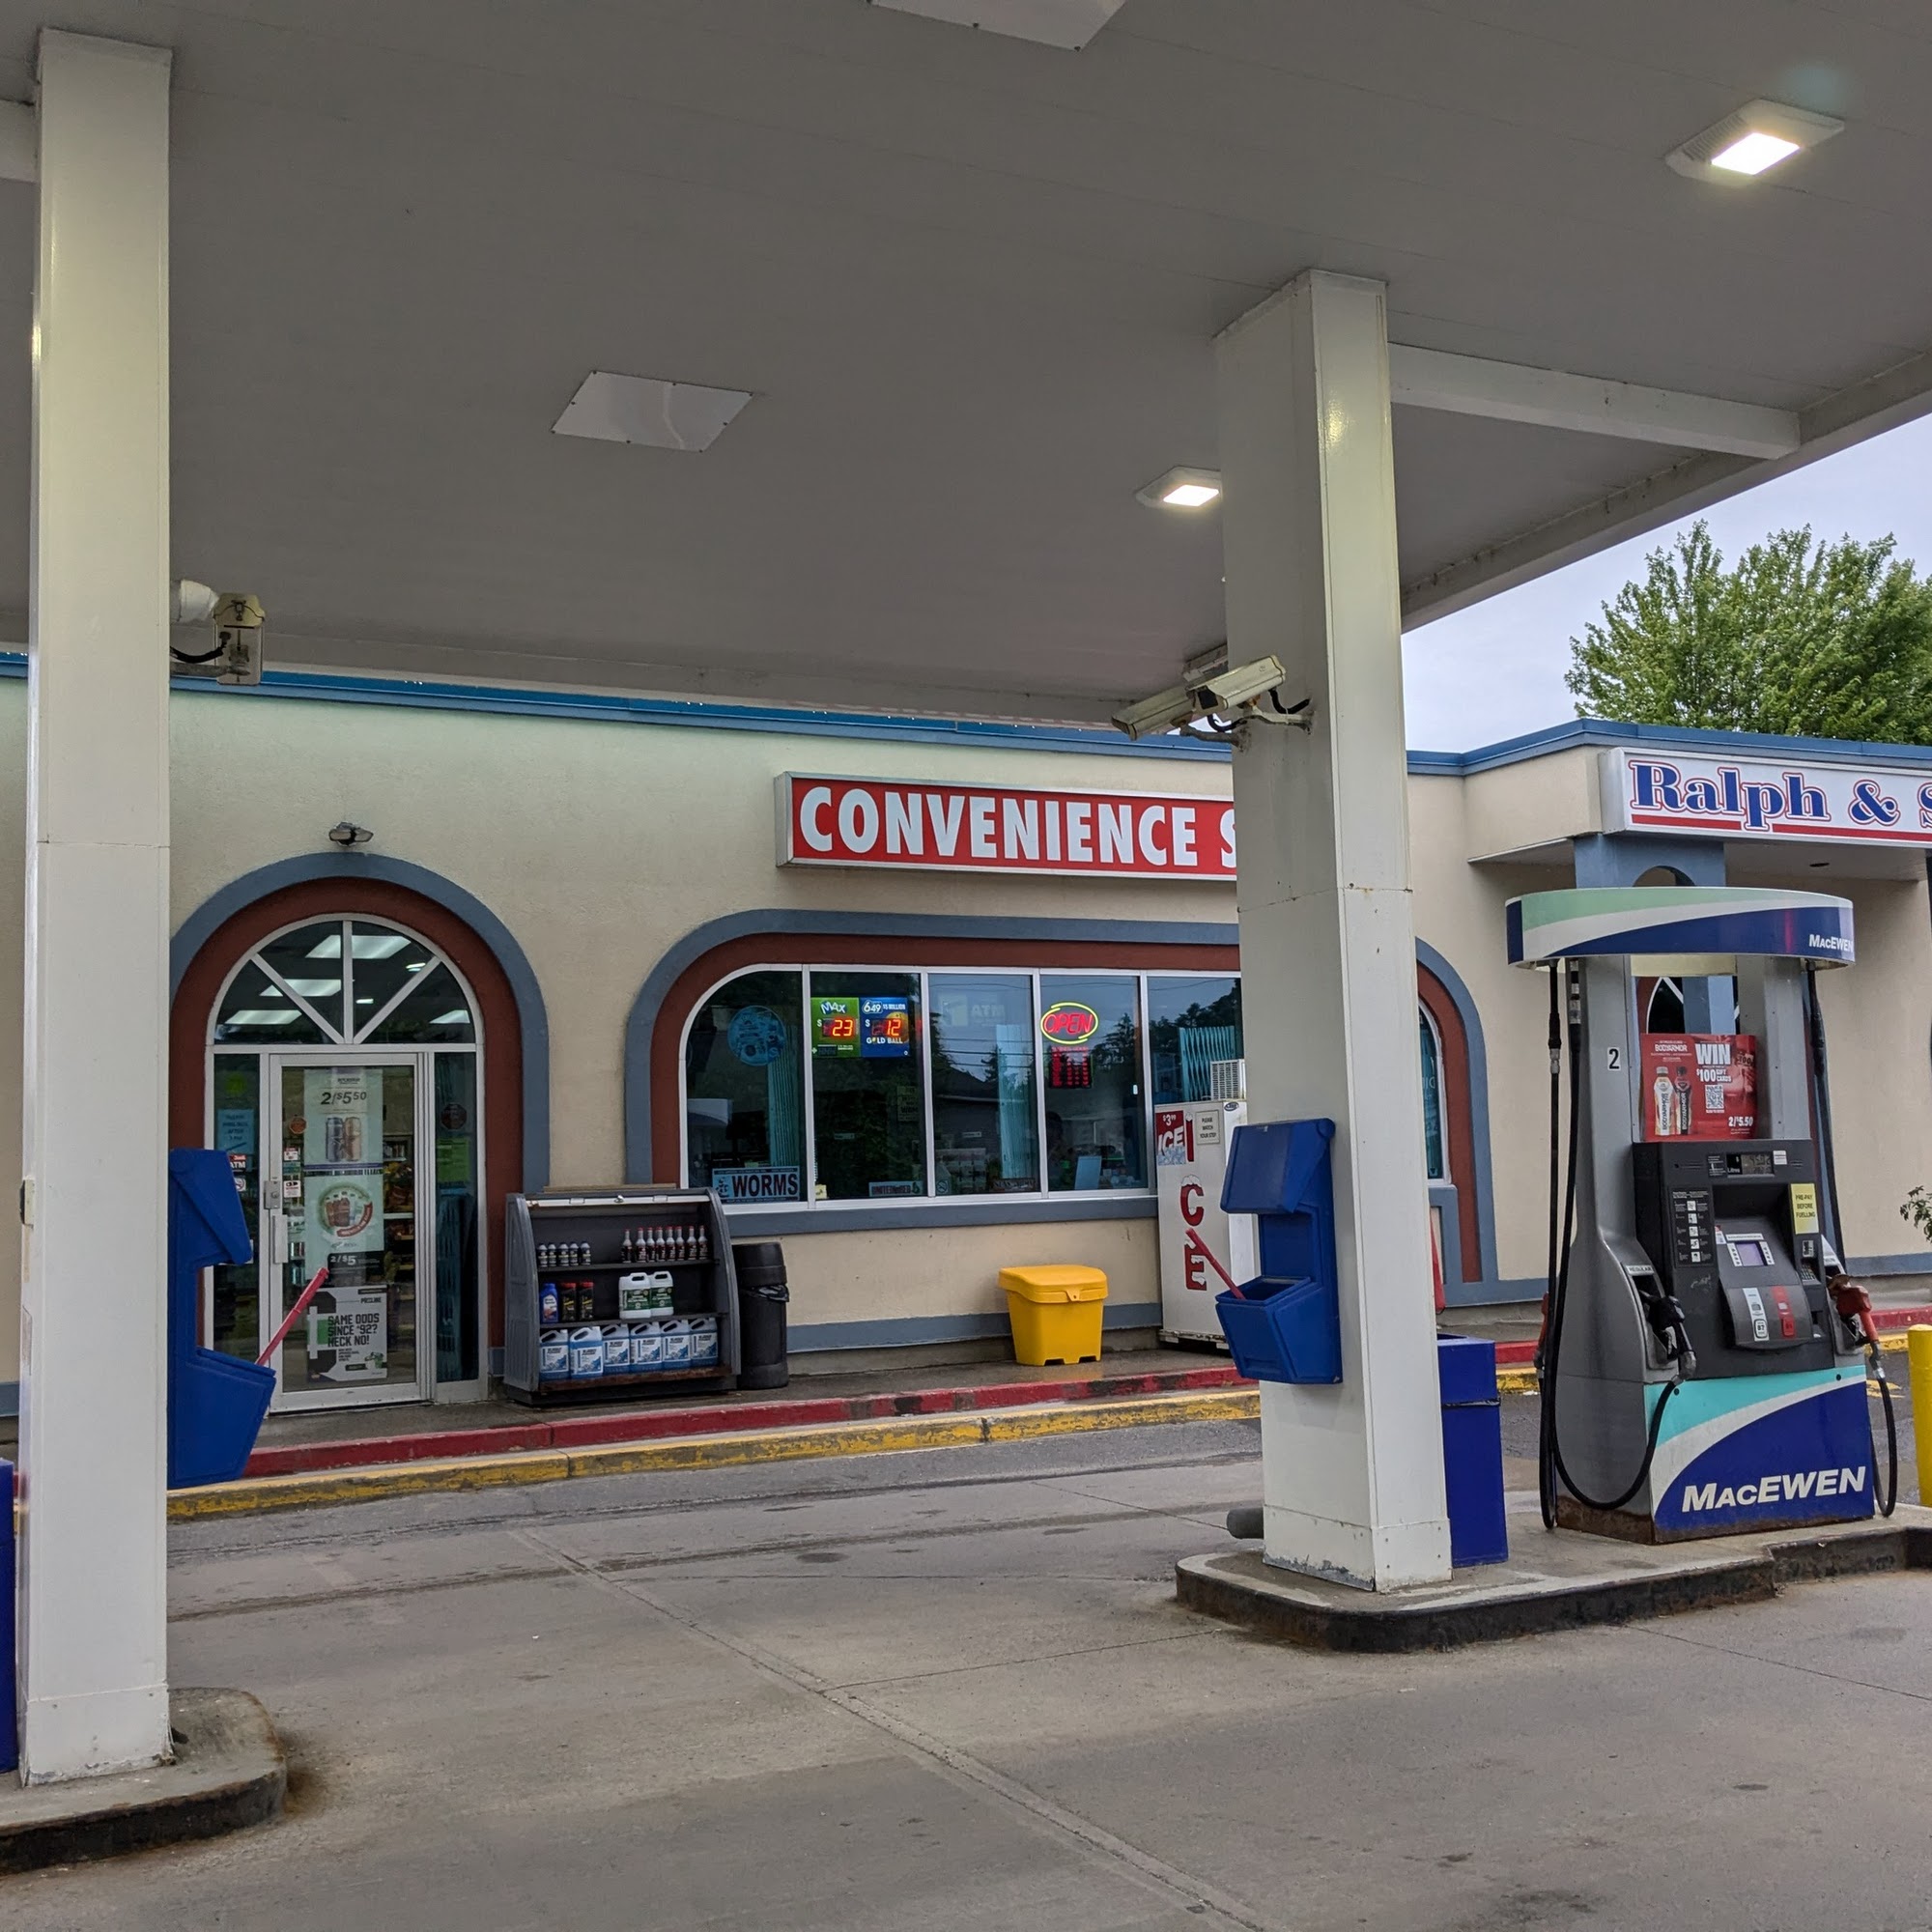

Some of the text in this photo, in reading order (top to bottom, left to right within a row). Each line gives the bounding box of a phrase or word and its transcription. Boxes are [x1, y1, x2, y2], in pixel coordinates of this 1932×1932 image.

[1629, 760, 1832, 832] Ralph
[1848, 780, 1900, 826] &
[800, 786, 1198, 867] CONVENIENCE
[820, 1001, 846, 1014] MAX
[832, 1019, 854, 1037] 23
[887, 1019, 901, 1037] 12
[1044, 1012, 1094, 1035] OPEN
[1608, 1048, 1620, 1069] 2
[1694, 1043, 1731, 1065] WIN
[1696, 1068, 1717, 1082] $100
[1157, 1126, 1184, 1157] ICE
[731, 1173, 798, 1198] WORMS
[328, 1314, 380, 1325] SAME ODDS
[328, 1325, 355, 1336] SINCE
[327, 1335, 370, 1347] HECK NO!
